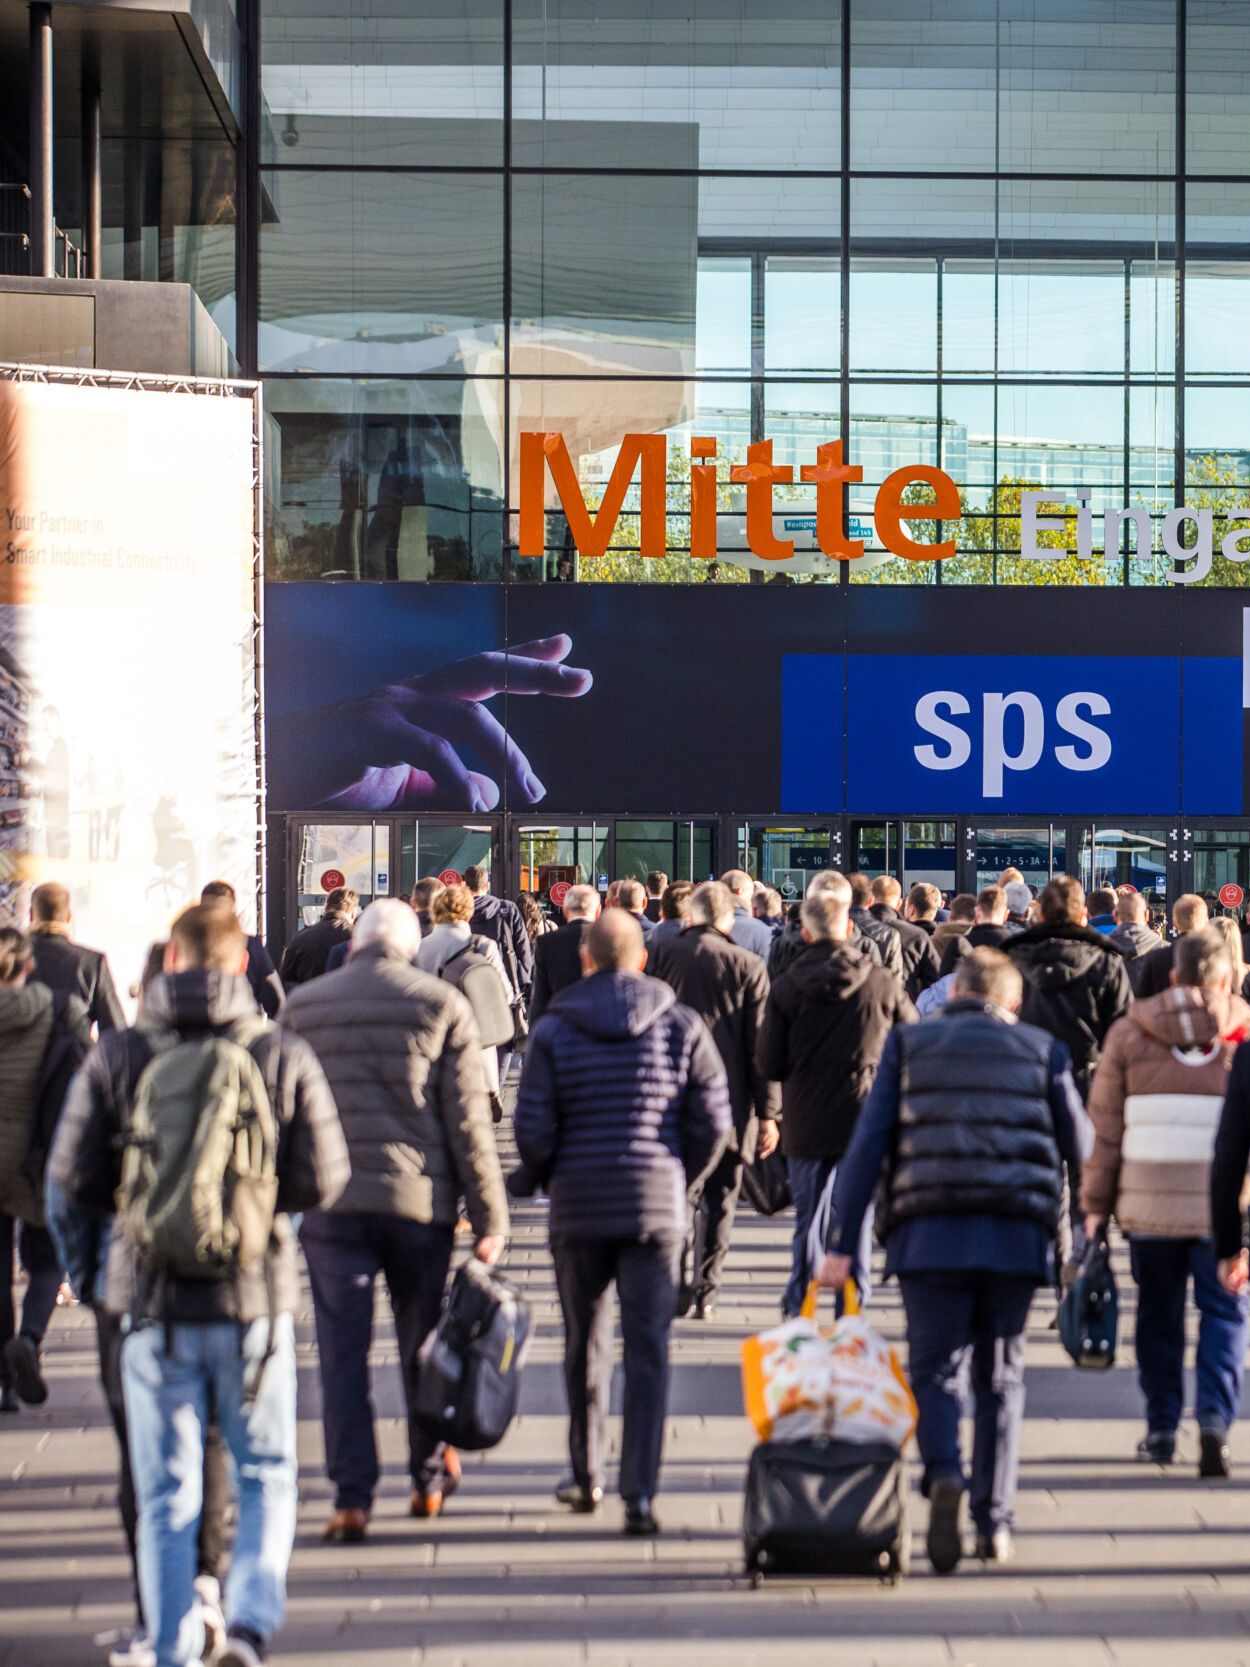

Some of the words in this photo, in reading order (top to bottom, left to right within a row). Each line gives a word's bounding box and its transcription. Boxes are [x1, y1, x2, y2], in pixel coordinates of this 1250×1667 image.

[6, 508, 37, 531] Your
[39, 509, 89, 535] Partner
[91, 512, 105, 535] in
[519, 432, 962, 562] Mitte
[6, 541, 48, 565] Smart
[50, 543, 114, 569] Industrial
[116, 546, 199, 577] Connectivity
[914, 690, 1112, 798] sps
